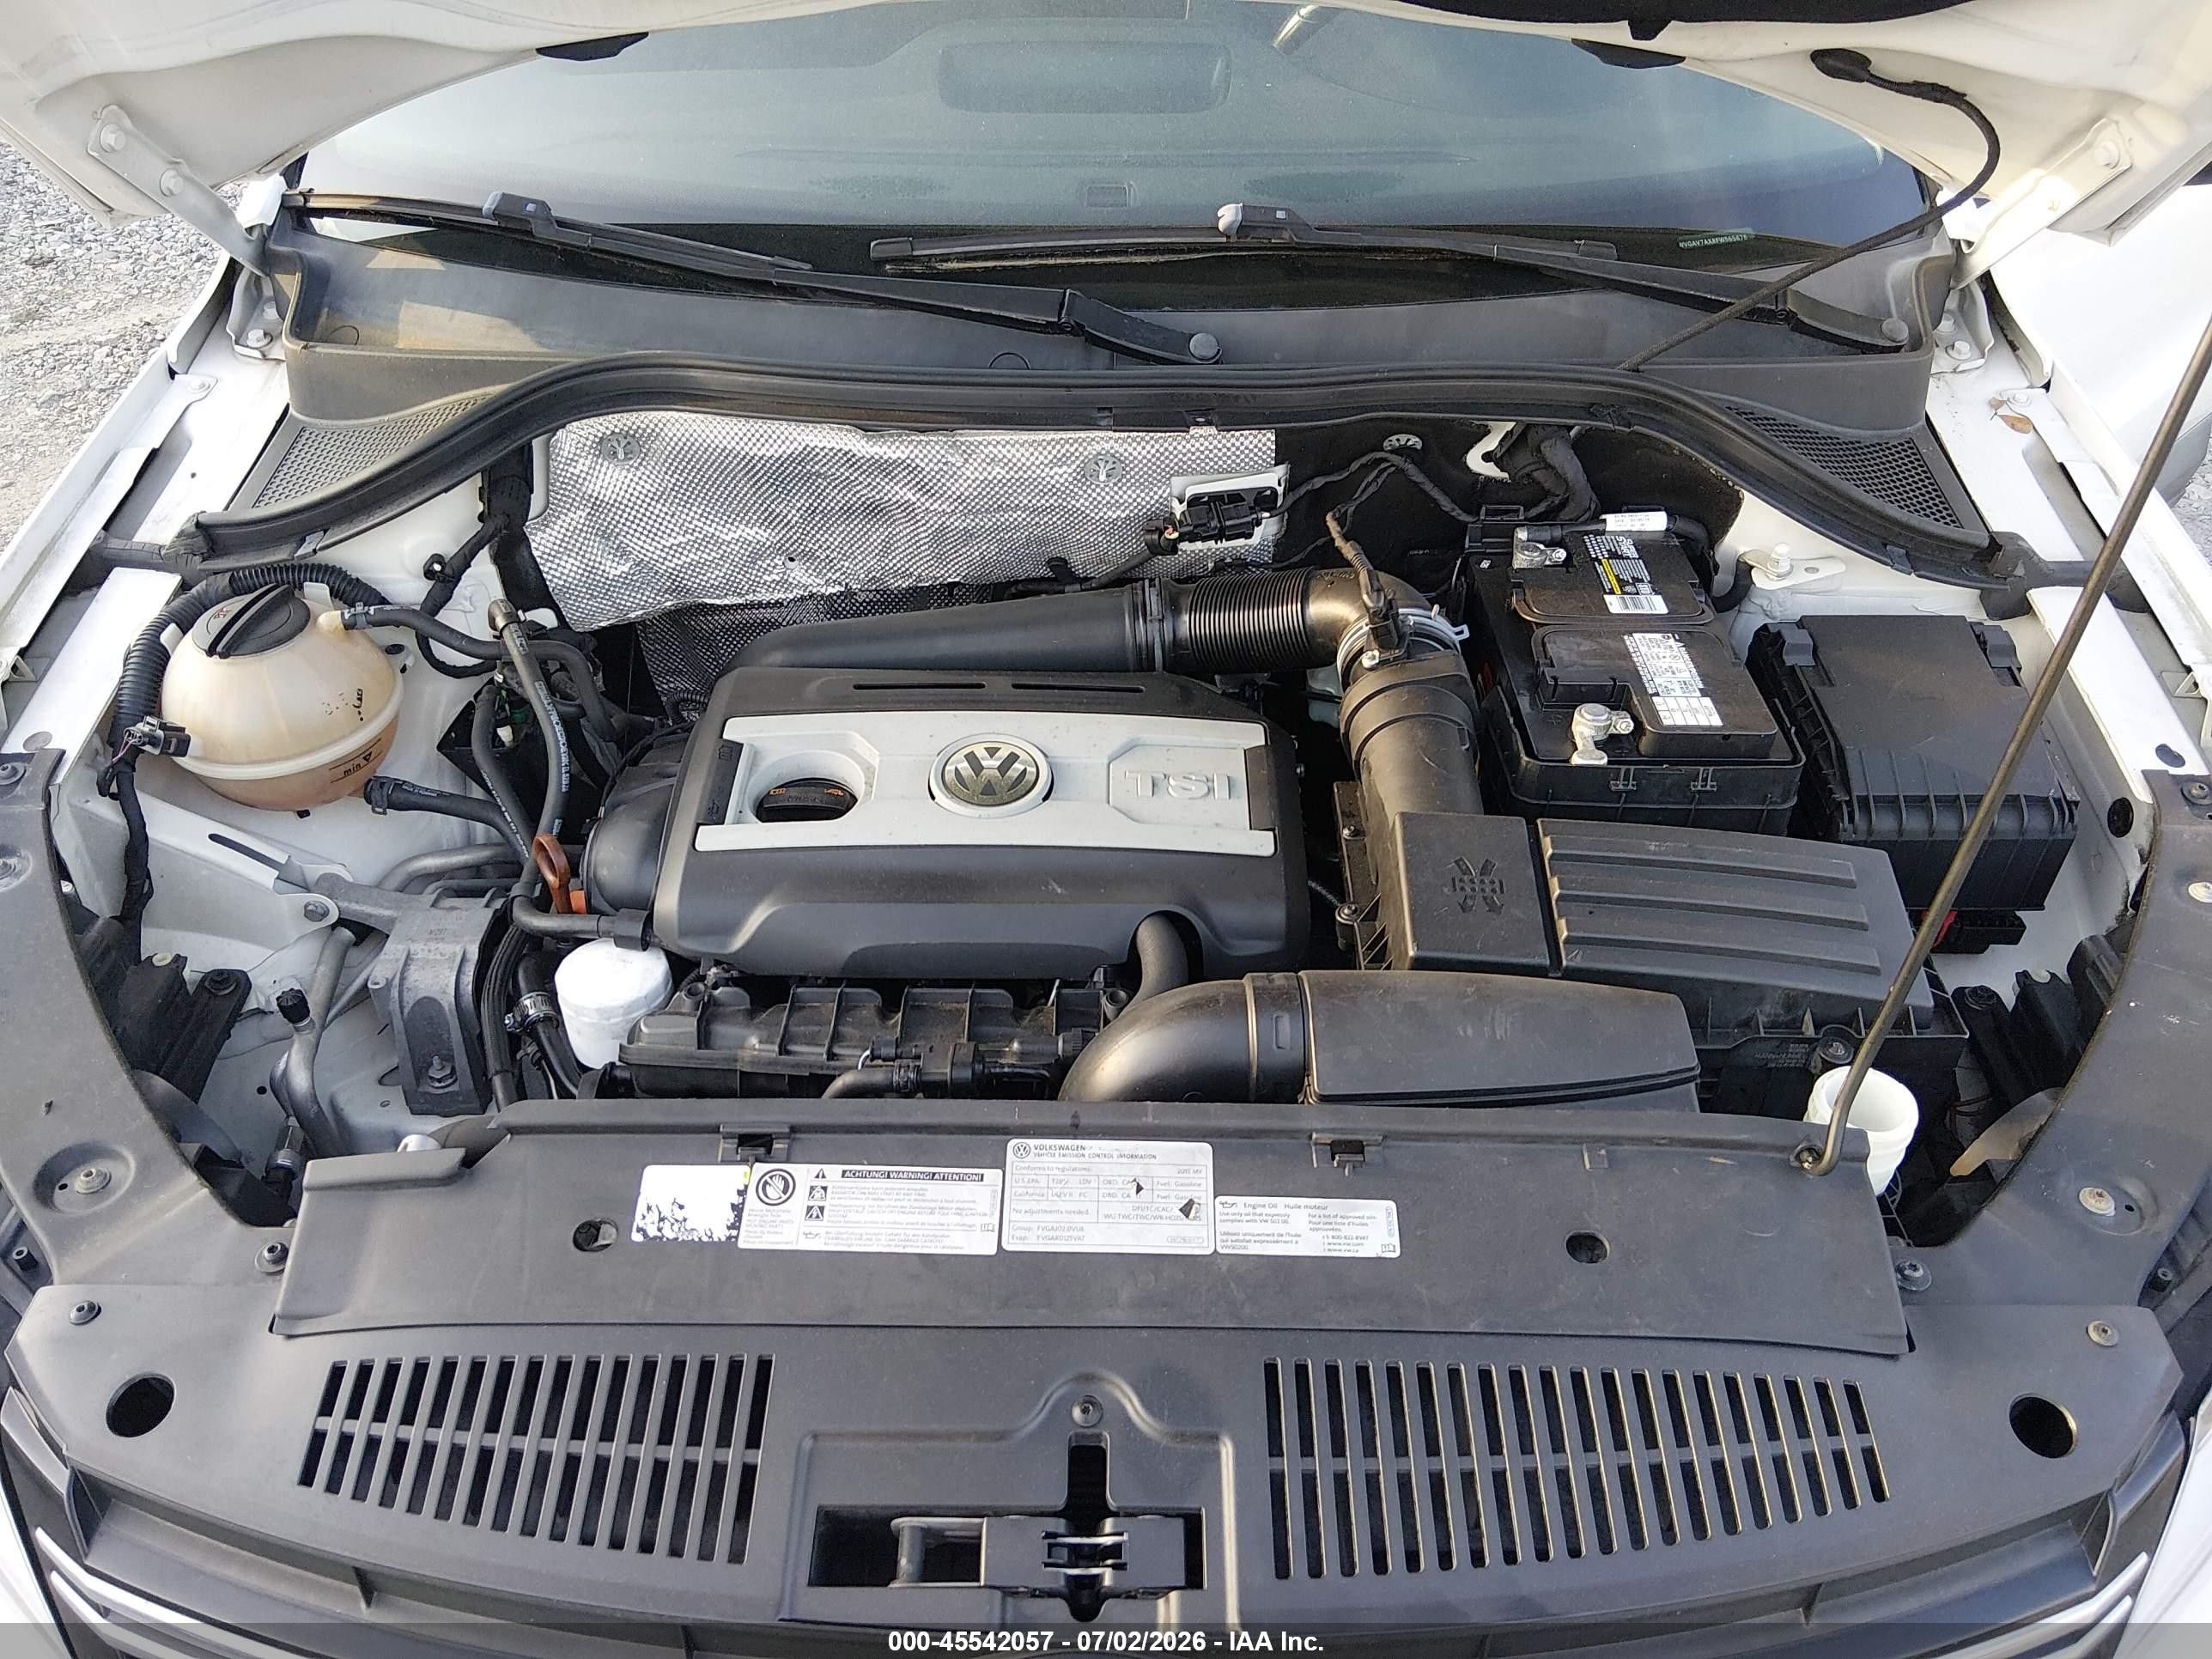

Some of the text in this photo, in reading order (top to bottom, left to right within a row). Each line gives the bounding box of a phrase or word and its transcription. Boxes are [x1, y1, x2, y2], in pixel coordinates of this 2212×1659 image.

[343, 763, 362, 775] min
[1126, 769, 1234, 802] TSI
[844, 1170, 981, 1182] ACHTUNG! WARNING! ATTENTION!
